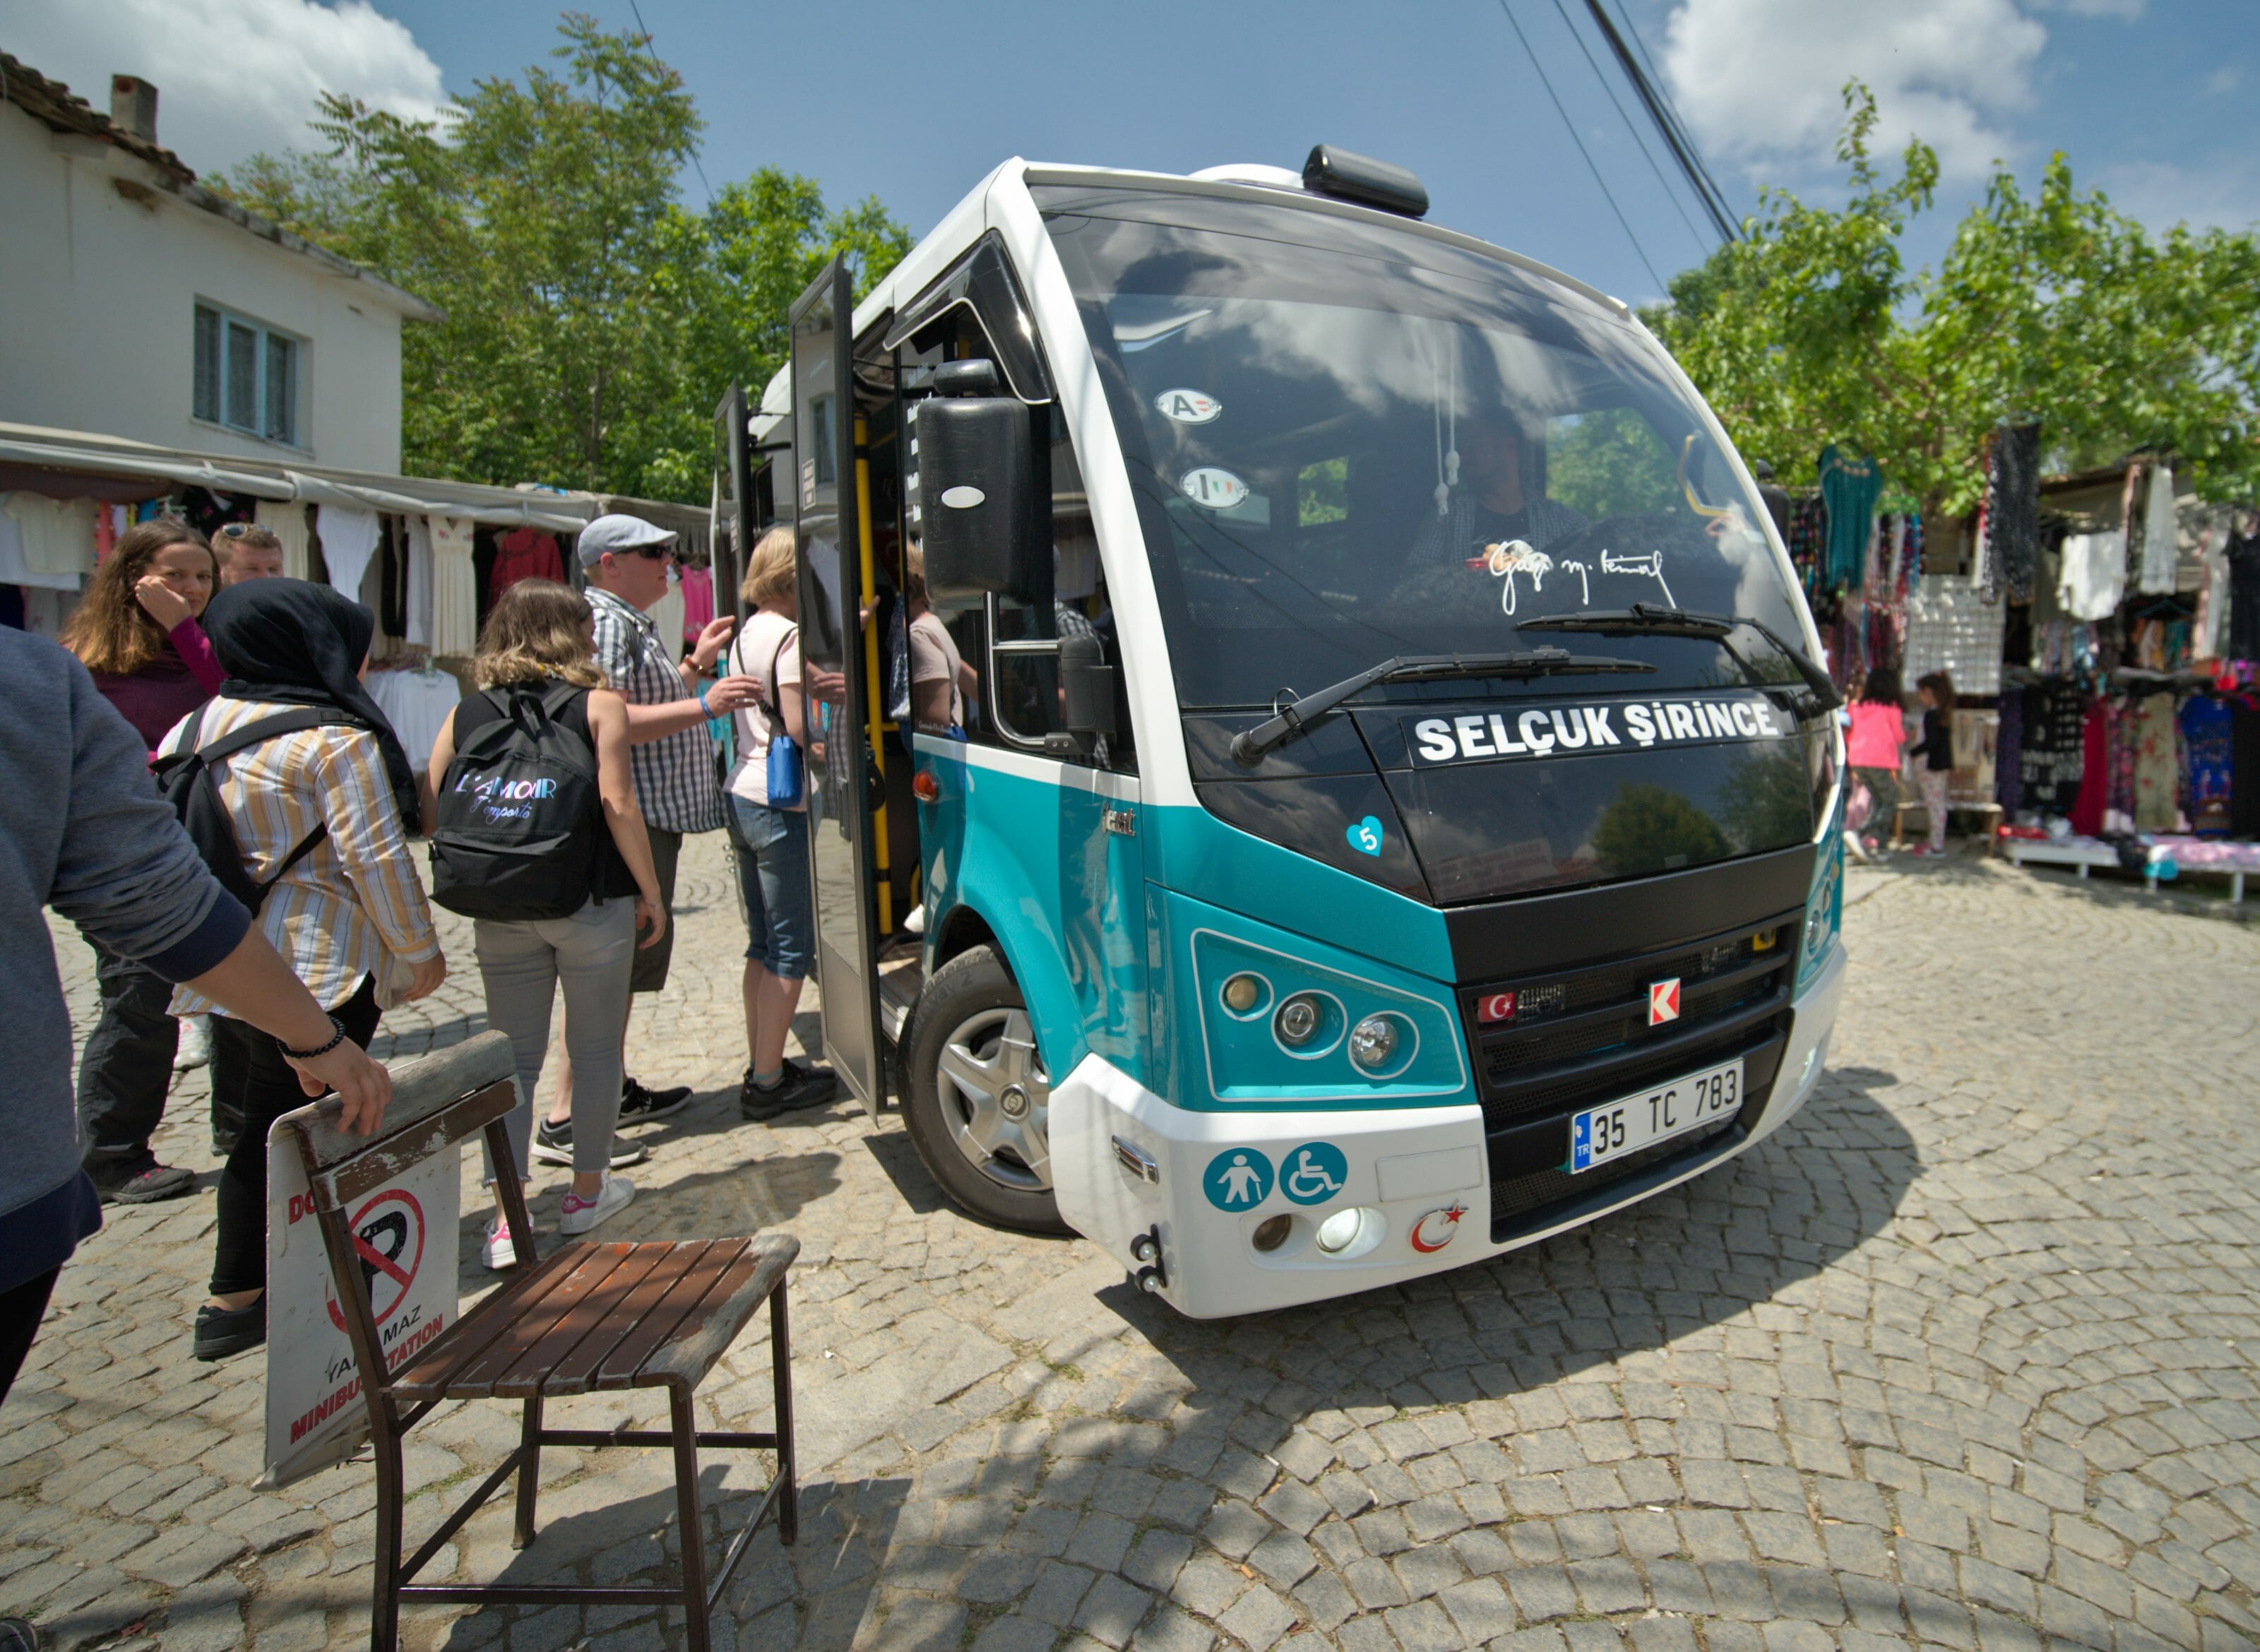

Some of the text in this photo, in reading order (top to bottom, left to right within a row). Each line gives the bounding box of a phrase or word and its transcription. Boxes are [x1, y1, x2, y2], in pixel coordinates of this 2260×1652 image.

[1173, 395, 1199, 416] A
[1415, 700, 1779, 762] SELÇUK ŞİRİNCE
[1359, 826, 1378, 850] 5
[1595, 1069, 1737, 1155] 35 TC 783
[1576, 1143, 1590, 1157] TR
[290, 1374, 365, 1446] MINIBU
